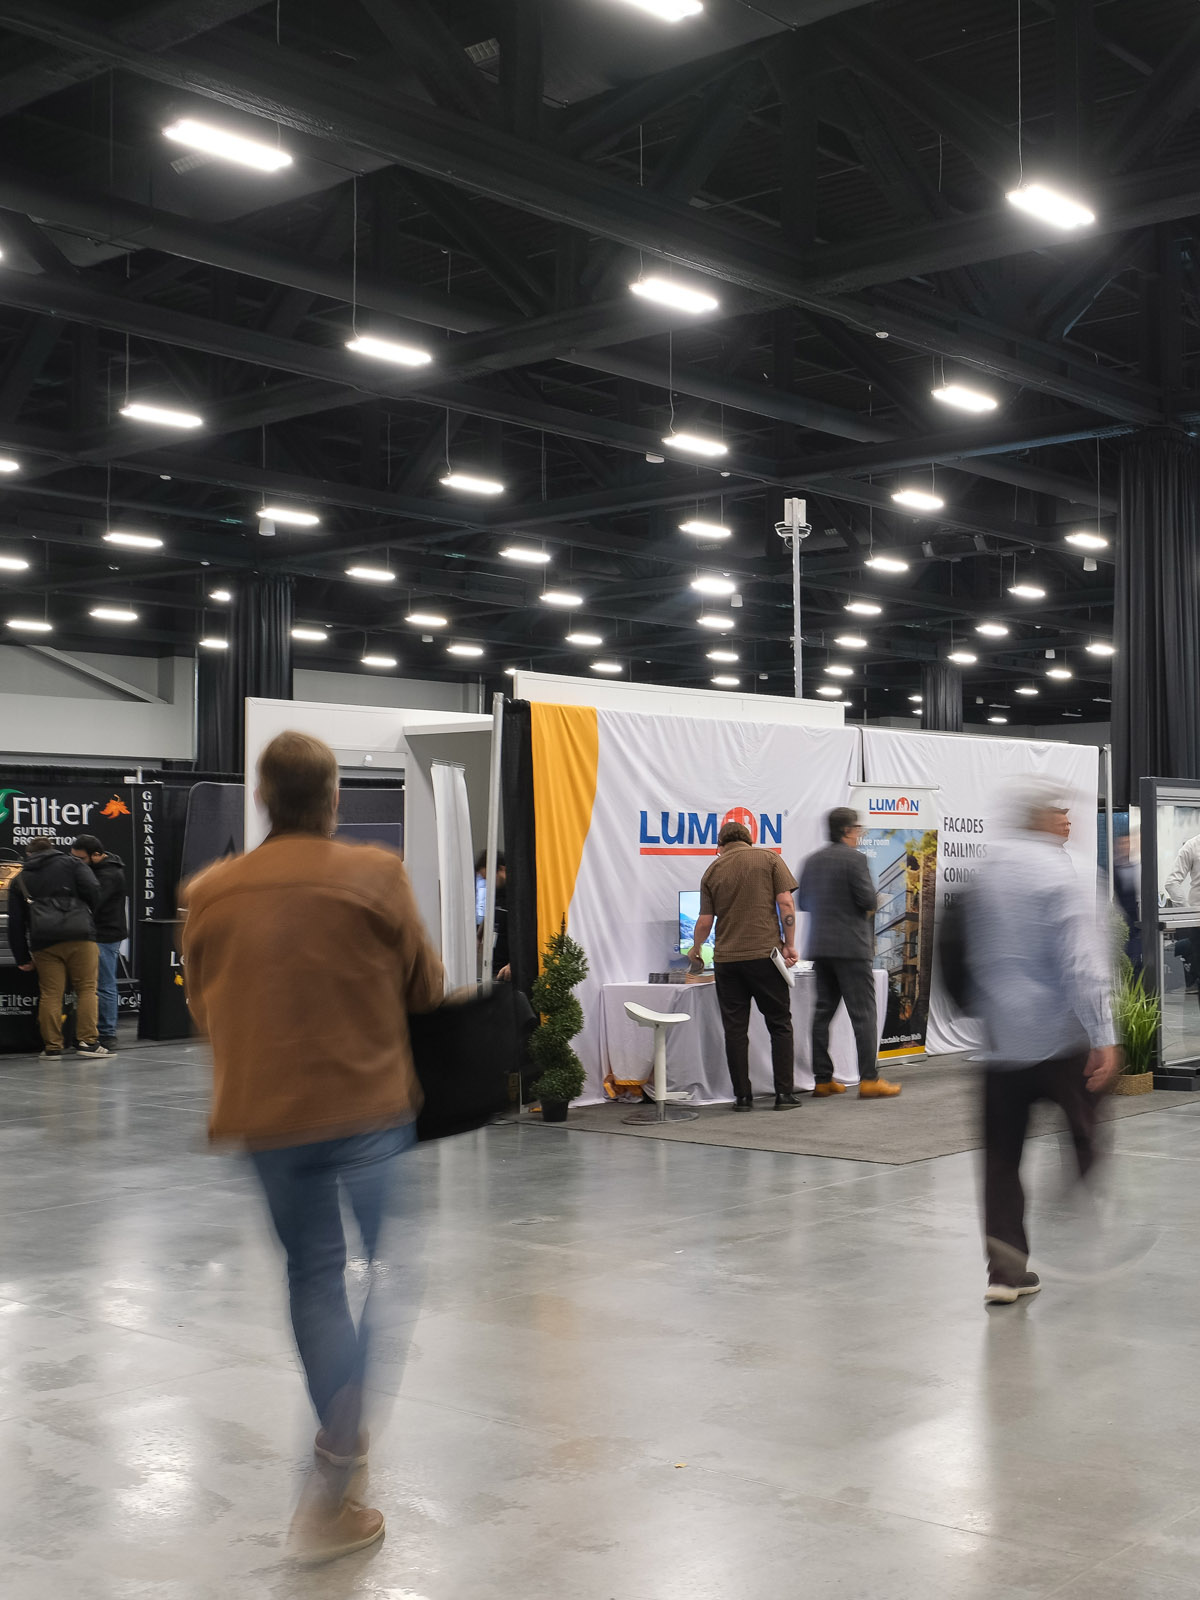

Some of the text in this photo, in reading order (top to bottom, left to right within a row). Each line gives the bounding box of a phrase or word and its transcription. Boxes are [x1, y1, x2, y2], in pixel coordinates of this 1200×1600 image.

[12, 797, 95, 825] Filter
[869, 797, 920, 812] LUMON
[13, 826, 57, 836] GUTTER
[943, 817, 984, 833] FACADES
[13, 836, 78, 846] PROCTION
[142, 791, 155, 900] GUARANTEED
[856, 837, 873, 846] More
[943, 842, 987, 858] RAILINGS
